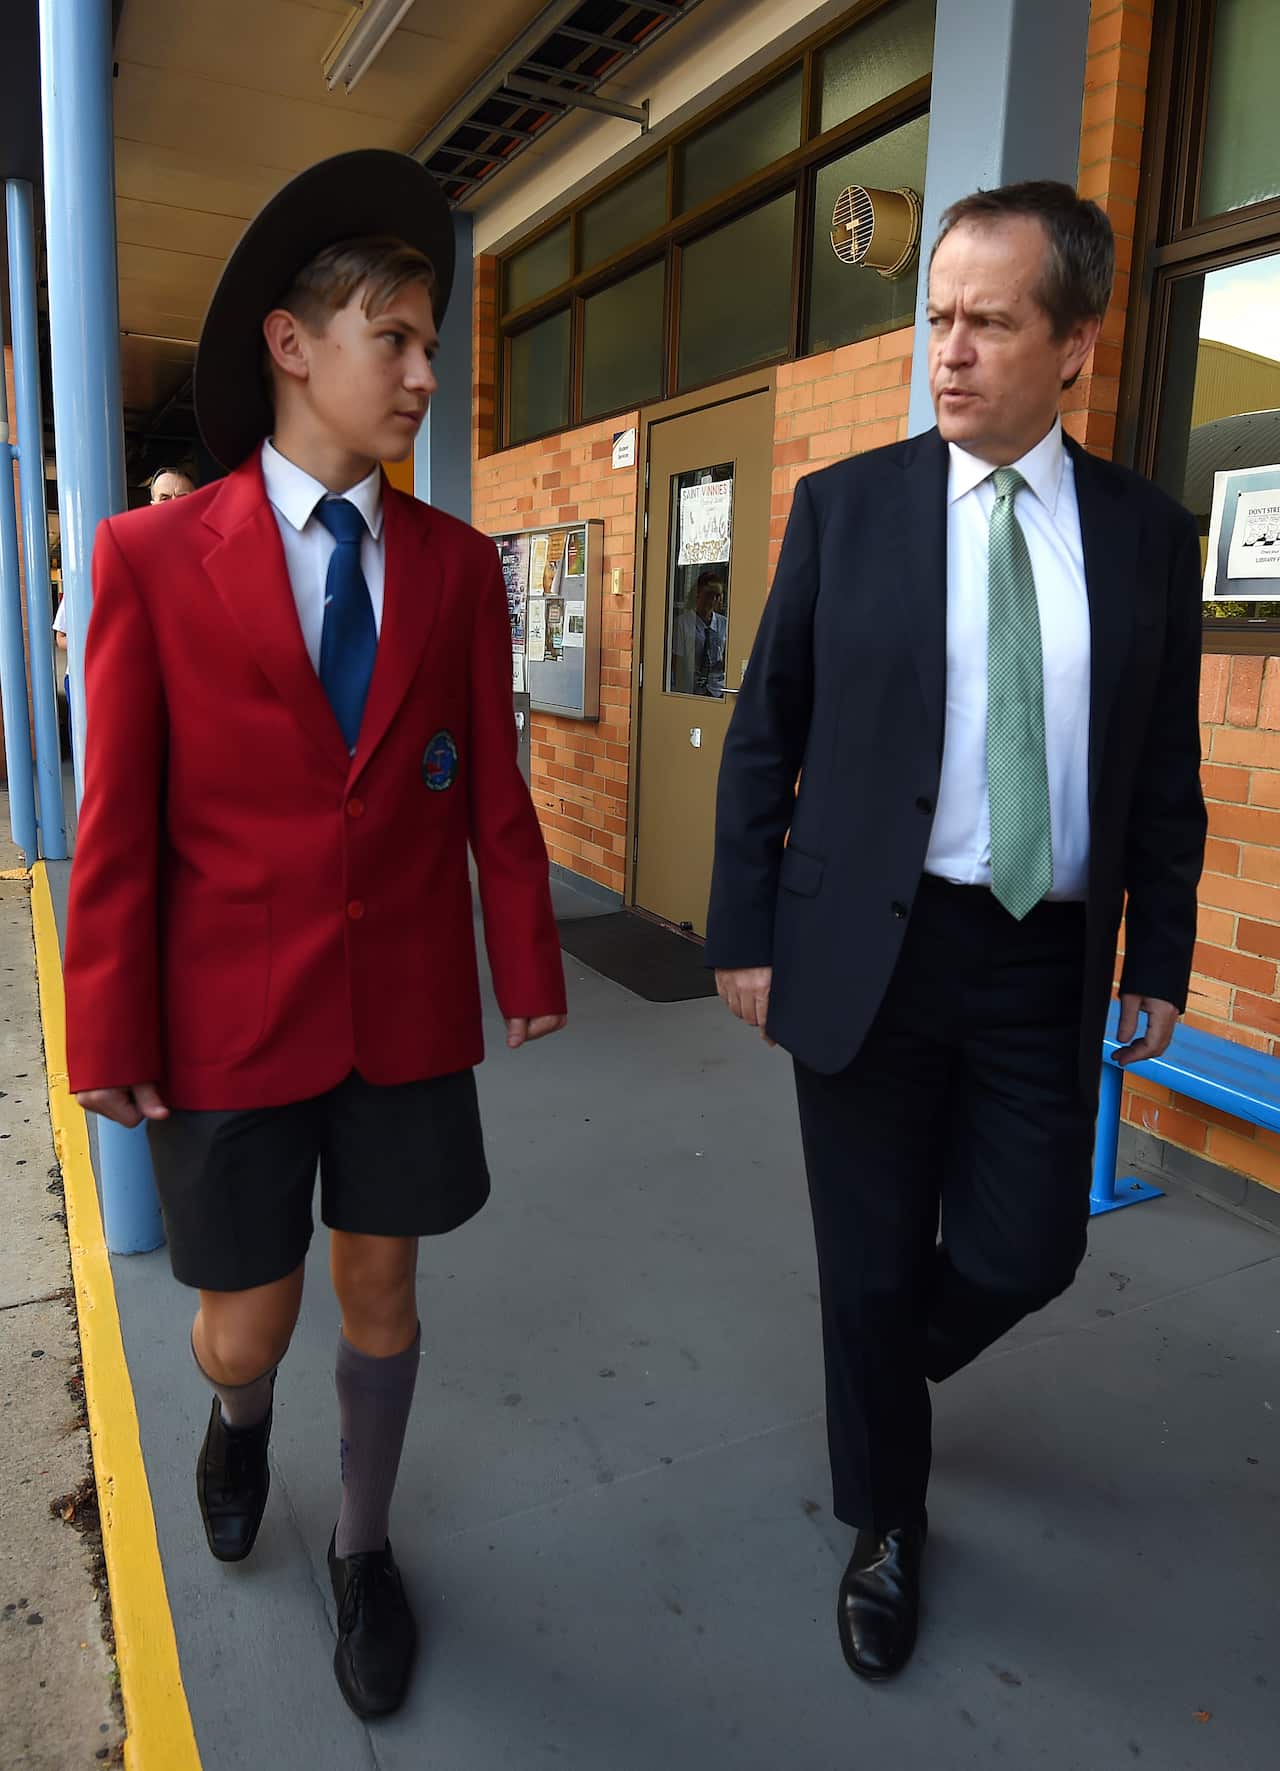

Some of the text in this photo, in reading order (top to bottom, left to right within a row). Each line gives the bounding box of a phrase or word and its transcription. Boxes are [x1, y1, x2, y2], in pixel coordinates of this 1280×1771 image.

[683, 483, 727, 499] SAINT VINNIES
[1248, 507, 1266, 515] DON'T
